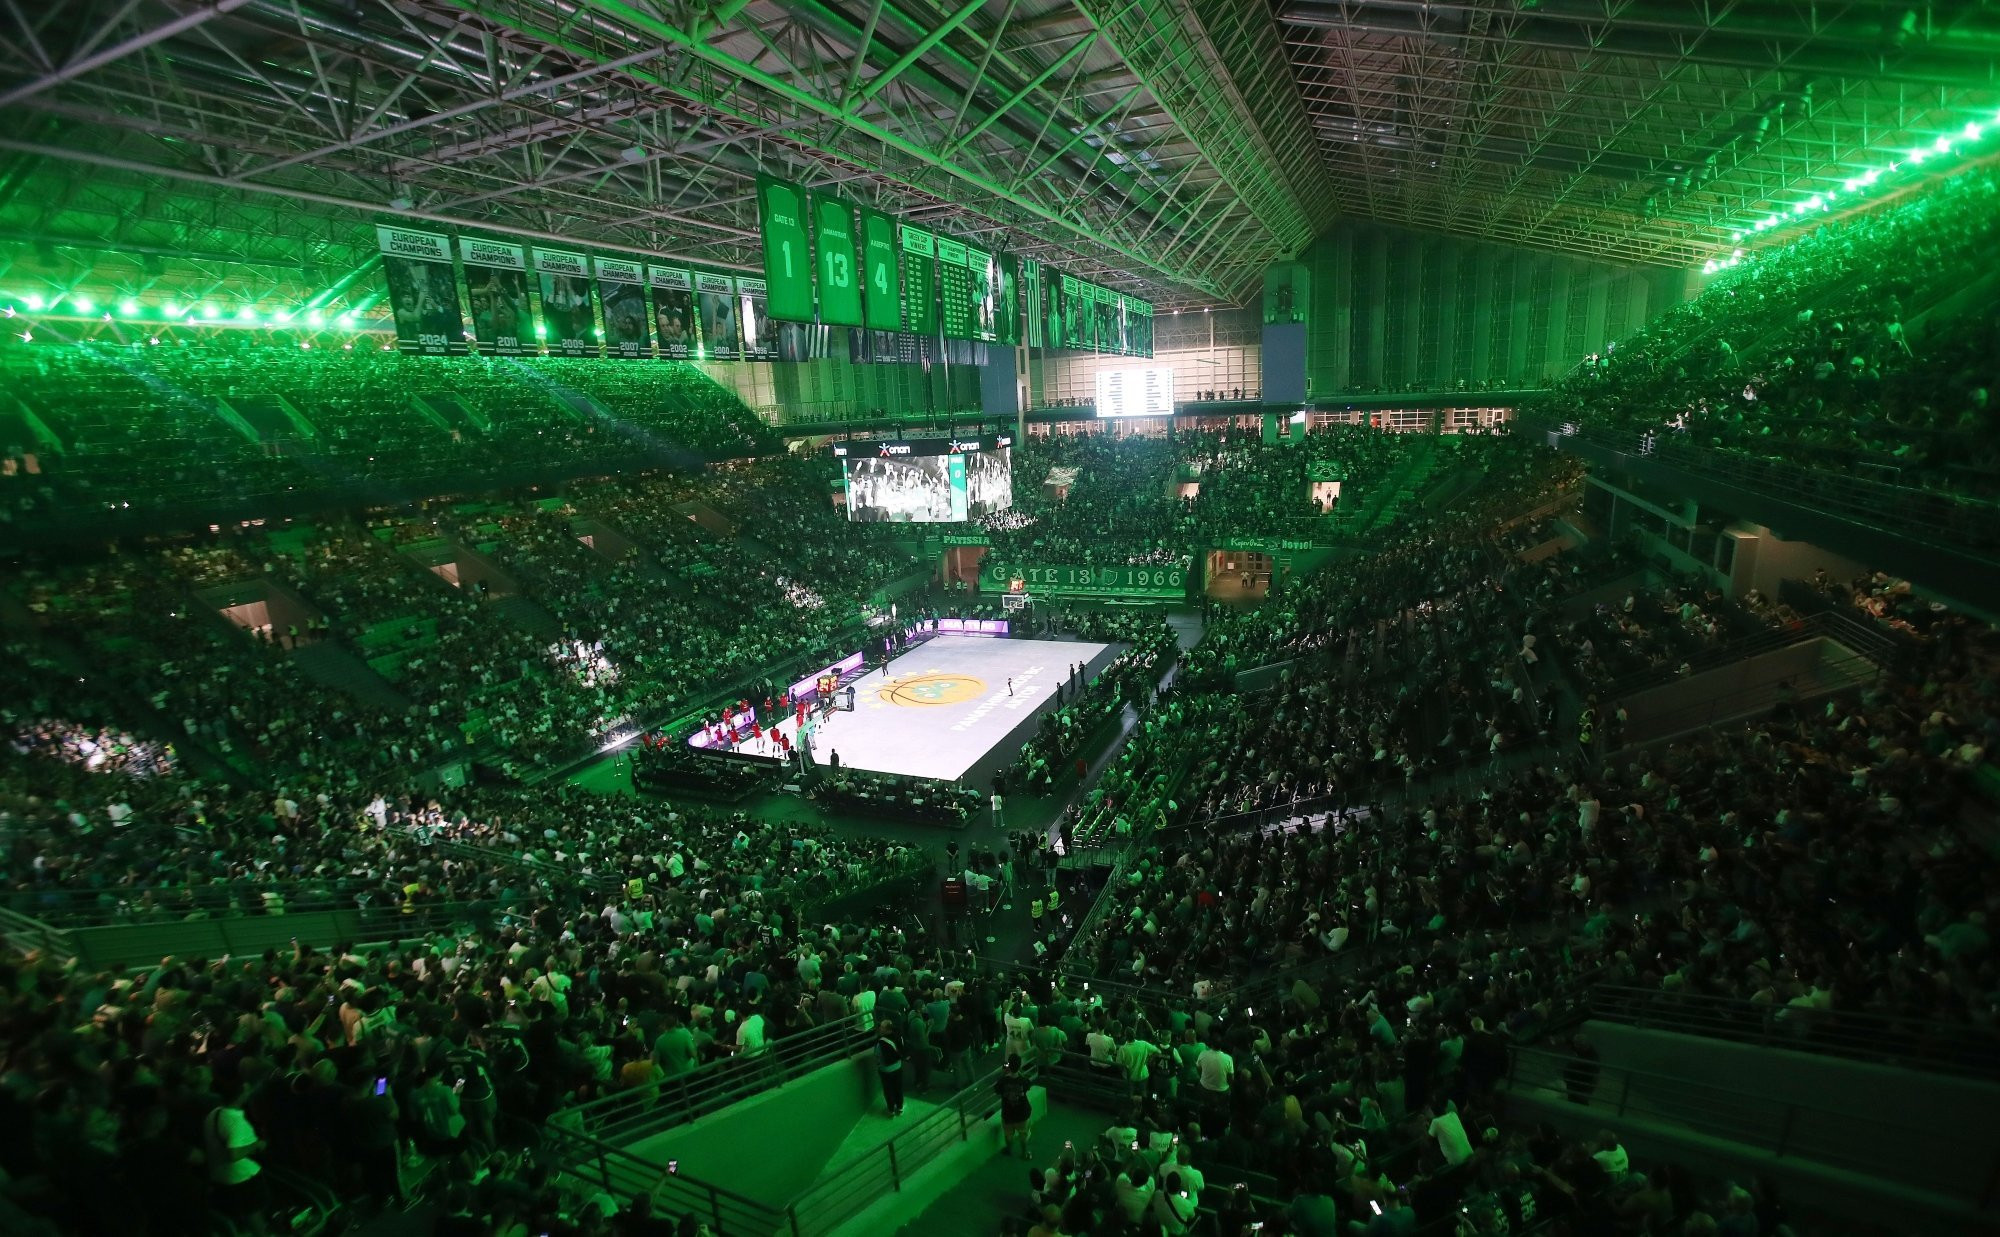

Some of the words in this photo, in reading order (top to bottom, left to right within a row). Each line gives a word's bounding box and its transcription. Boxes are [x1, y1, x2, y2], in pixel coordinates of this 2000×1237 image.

[391, 232, 437, 247] EUROPEAN
[390, 242, 442, 257] CHAMPIONS
[472, 242, 512, 256] EUROPEAN
[470, 251, 516, 265] CHAMPIONS
[543, 253, 578, 265] EUROPEAN
[782, 240, 792, 278] 1
[541, 261, 581, 273] CHAMPIONS
[603, 262, 634, 273] EUROPEAN
[825, 251, 849, 288] 13
[602, 269, 637, 280] CHAMPIONS
[656, 270, 683, 280] EUROPEAN
[874, 262, 888, 295] 4
[655, 277, 686, 287] CHAMPIONS
[702, 276, 726, 286] EUROPEAN
[701, 283, 729, 293] CHAMPIONS
[418, 334, 448, 346] 2024
[497, 336, 518, 347] 2011
[562, 339, 584, 349] 2009
[620, 342, 639, 351] 2007
[669, 344, 688, 353] 2002
[714, 346, 730, 355] 2000
[943, 535, 990, 545] PATISSIA
[992, 566, 1059, 583] GATE
[1068, 568, 1091, 584] 13
[1127, 570, 1180, 587] 1966
[949, 674, 1034, 731] PANATHINAKOS
